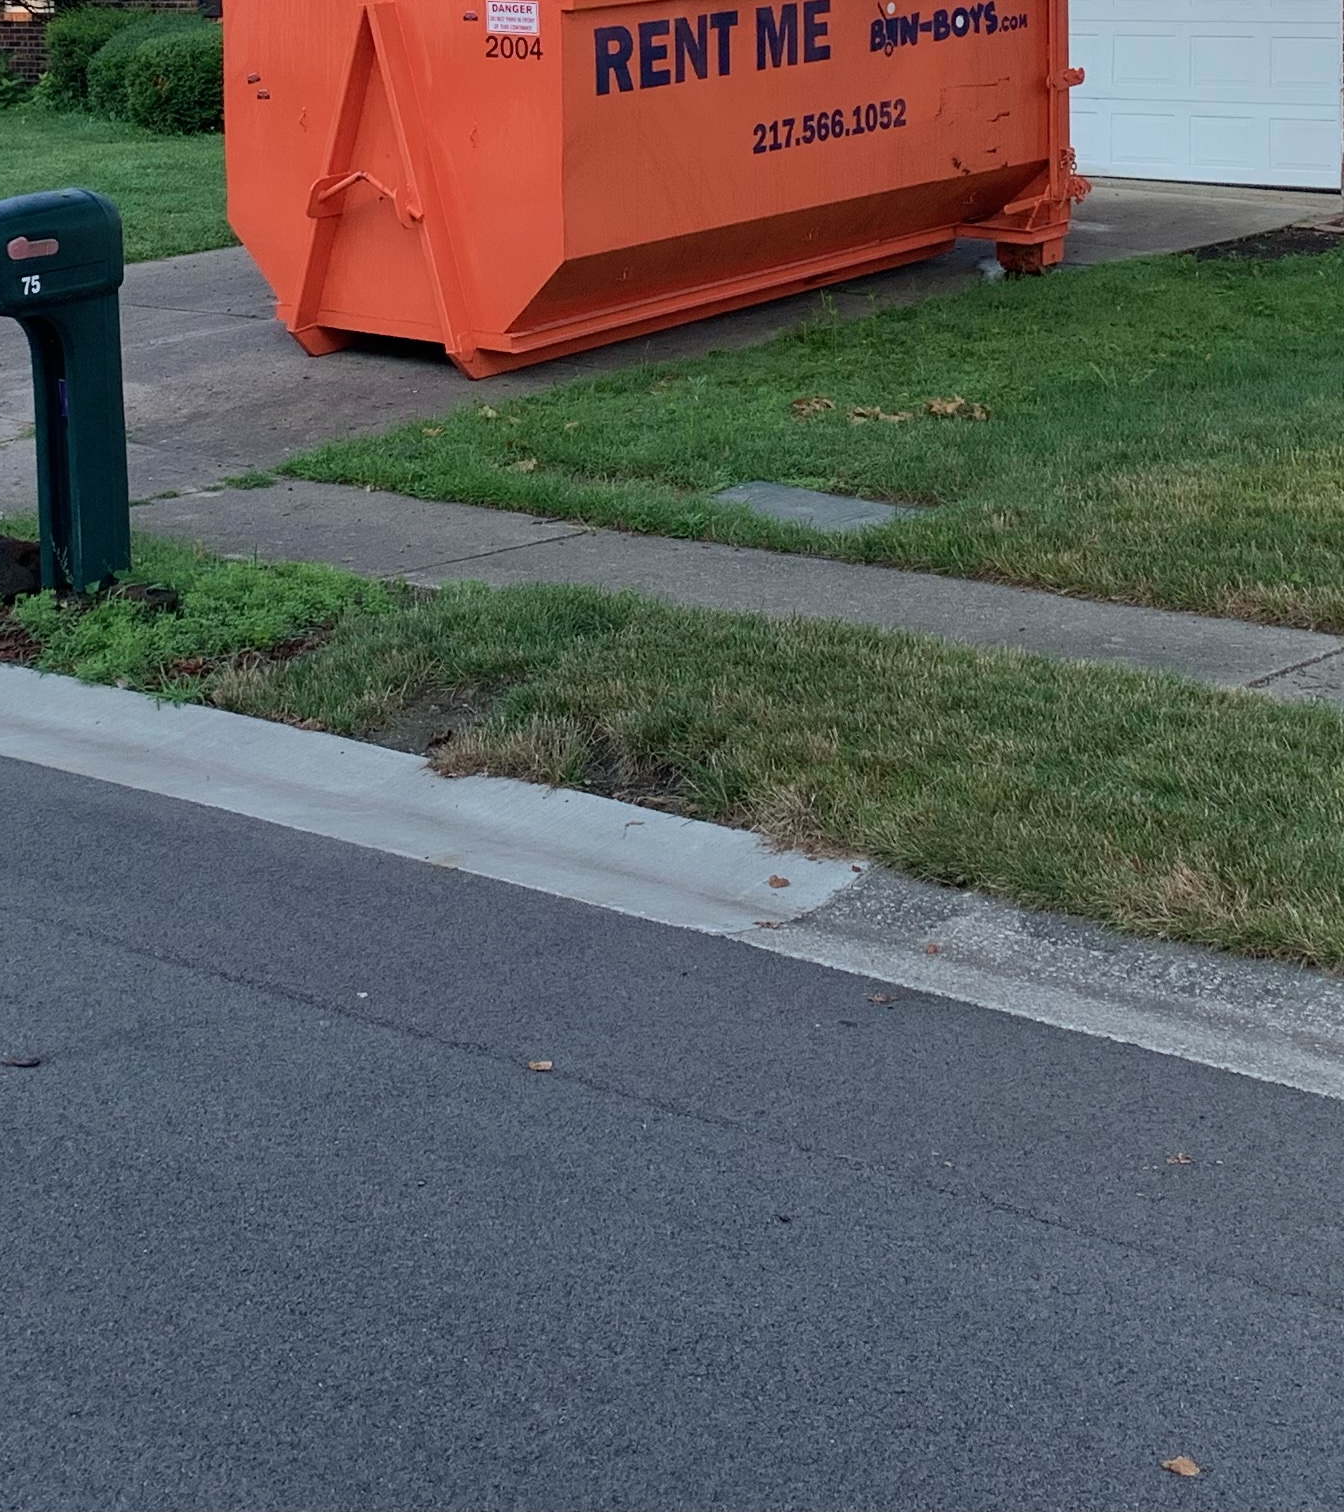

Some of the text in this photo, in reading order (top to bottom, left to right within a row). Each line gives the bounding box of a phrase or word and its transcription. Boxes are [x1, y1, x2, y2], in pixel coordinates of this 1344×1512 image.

[492, 3, 533, 14] DANGER
[485, 35, 544, 61] 2004
[593, 10, 739, 96] RENT
[752, 98, 907, 154] 217.566.1052
[21, 274, 41, 296] 75
